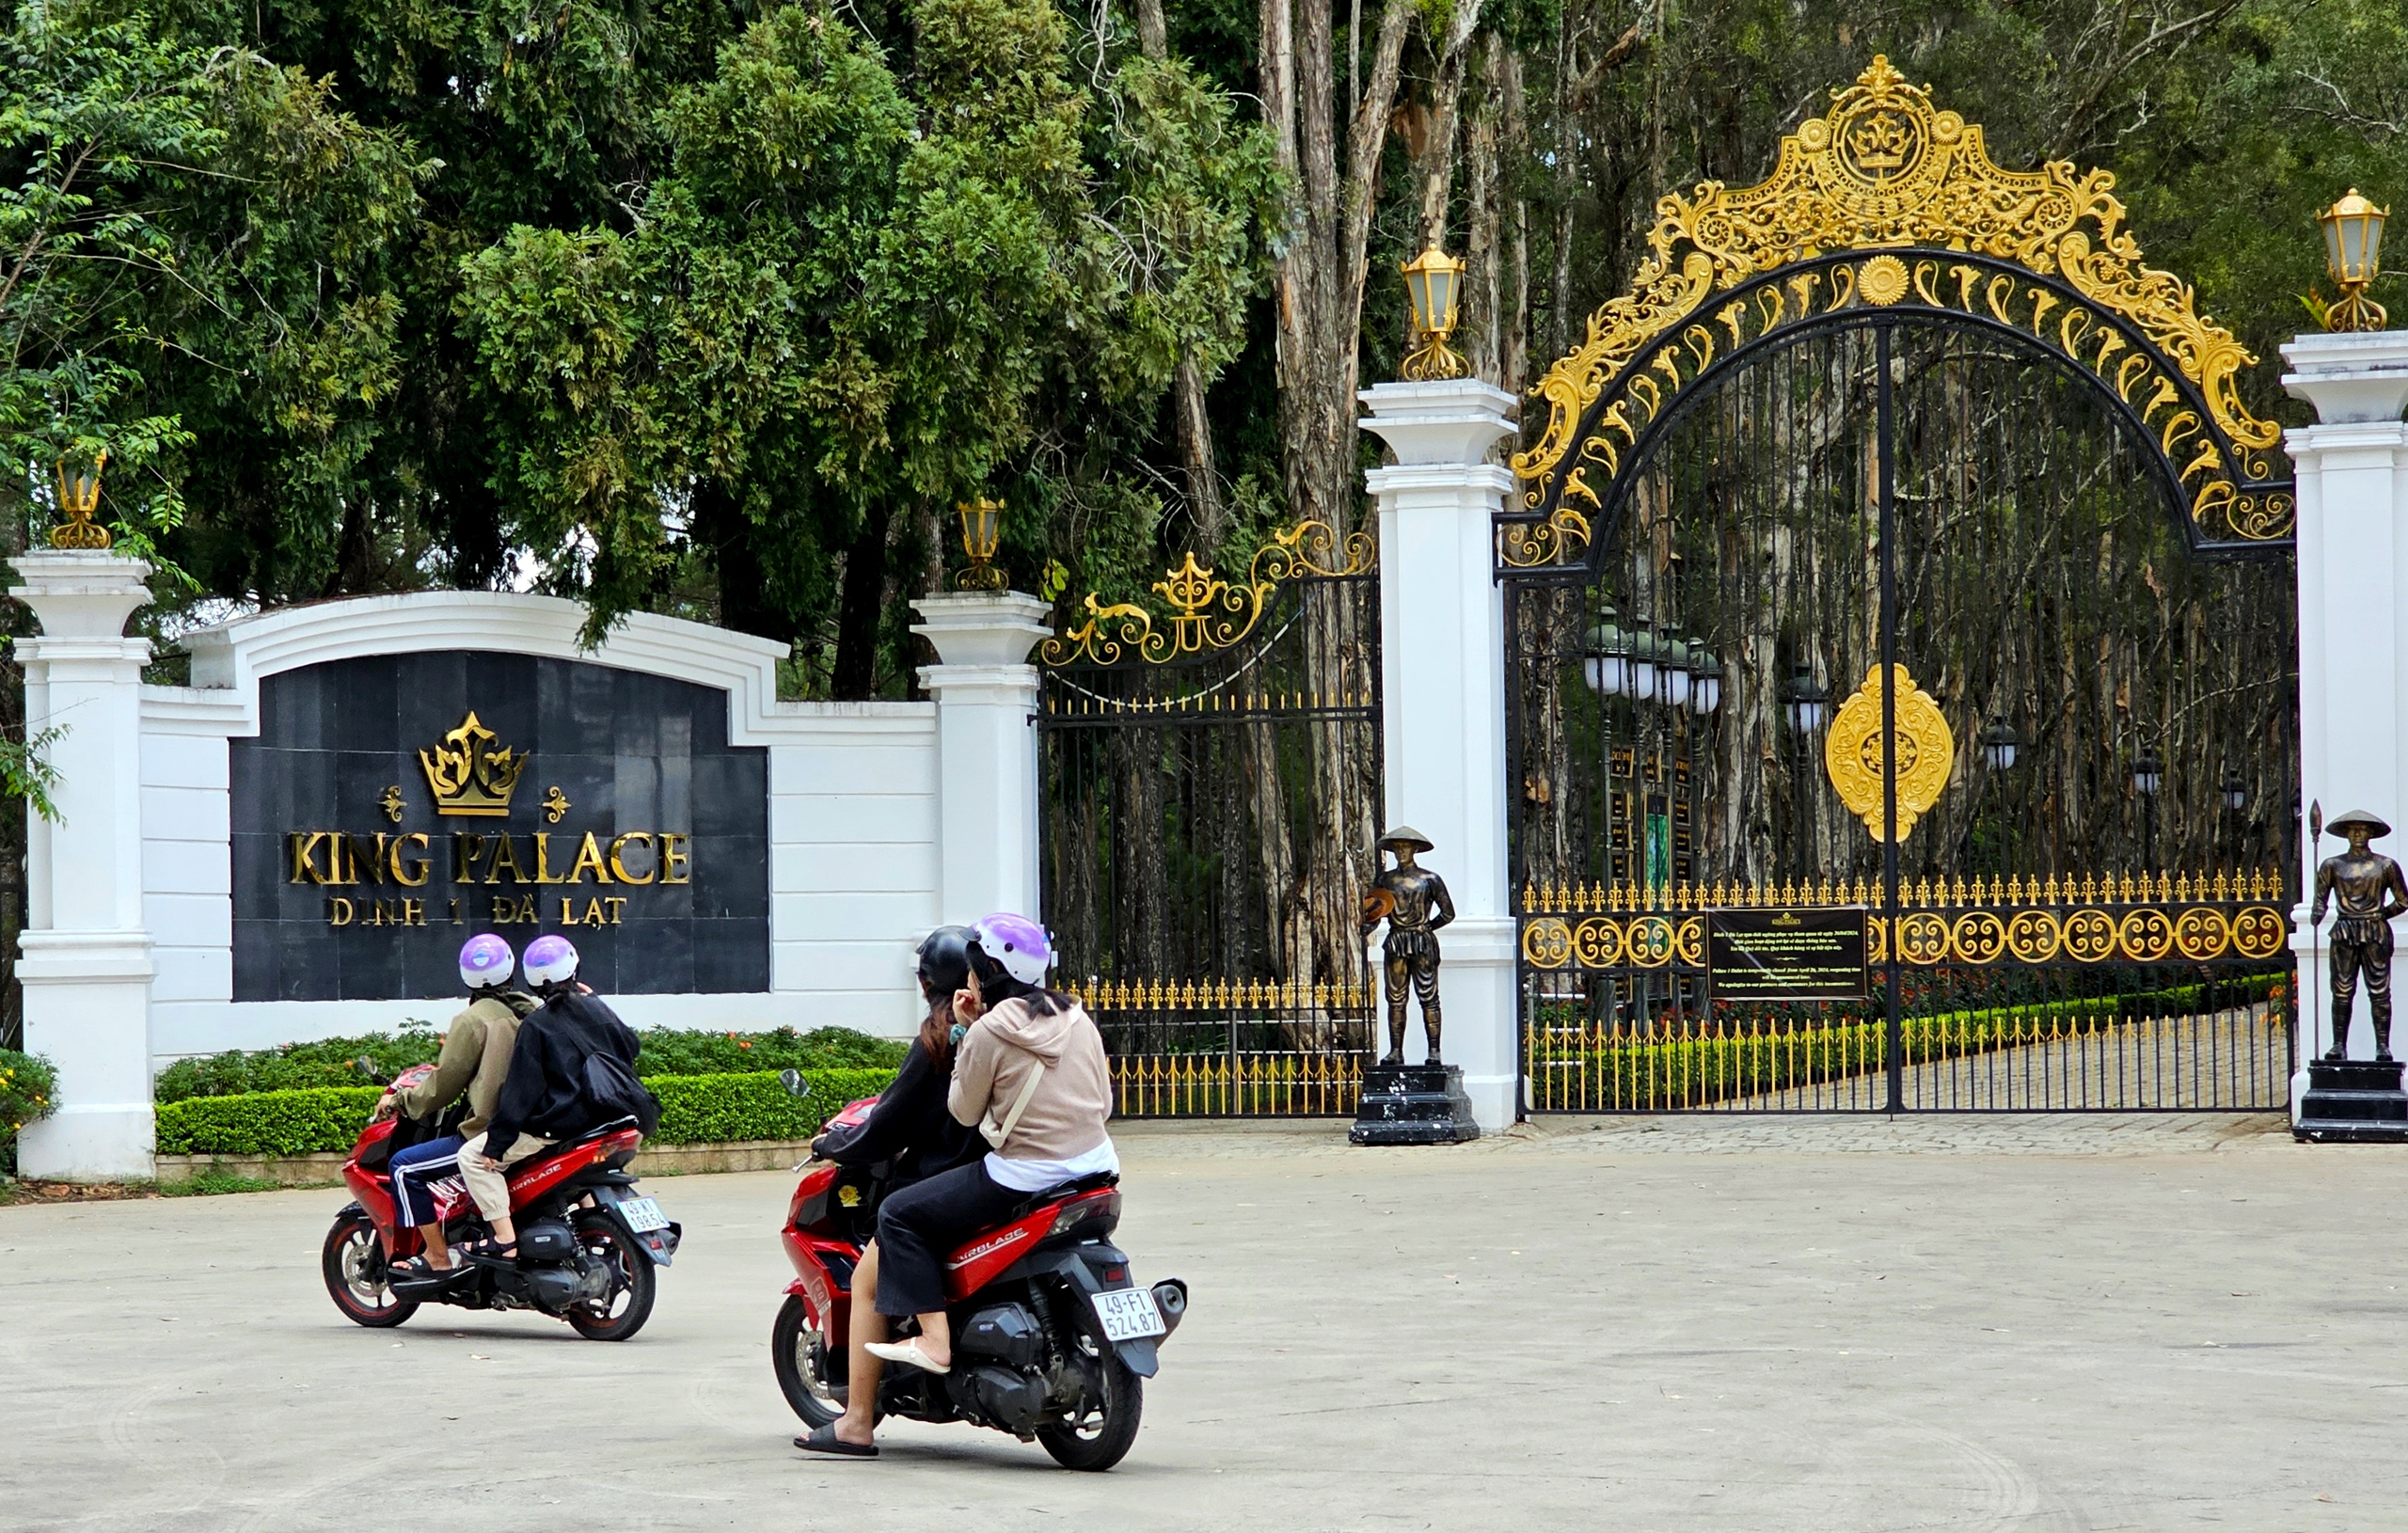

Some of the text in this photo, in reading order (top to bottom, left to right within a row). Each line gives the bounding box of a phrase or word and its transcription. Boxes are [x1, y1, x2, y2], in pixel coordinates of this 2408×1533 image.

[289, 830, 691, 886] KING PALACE
[329, 893, 627, 930] DINH 1 ĐÀ LẠT
[1104, 1292, 1146, 1315] 49-F1
[1105, 1312, 1157, 1337] 524.87
